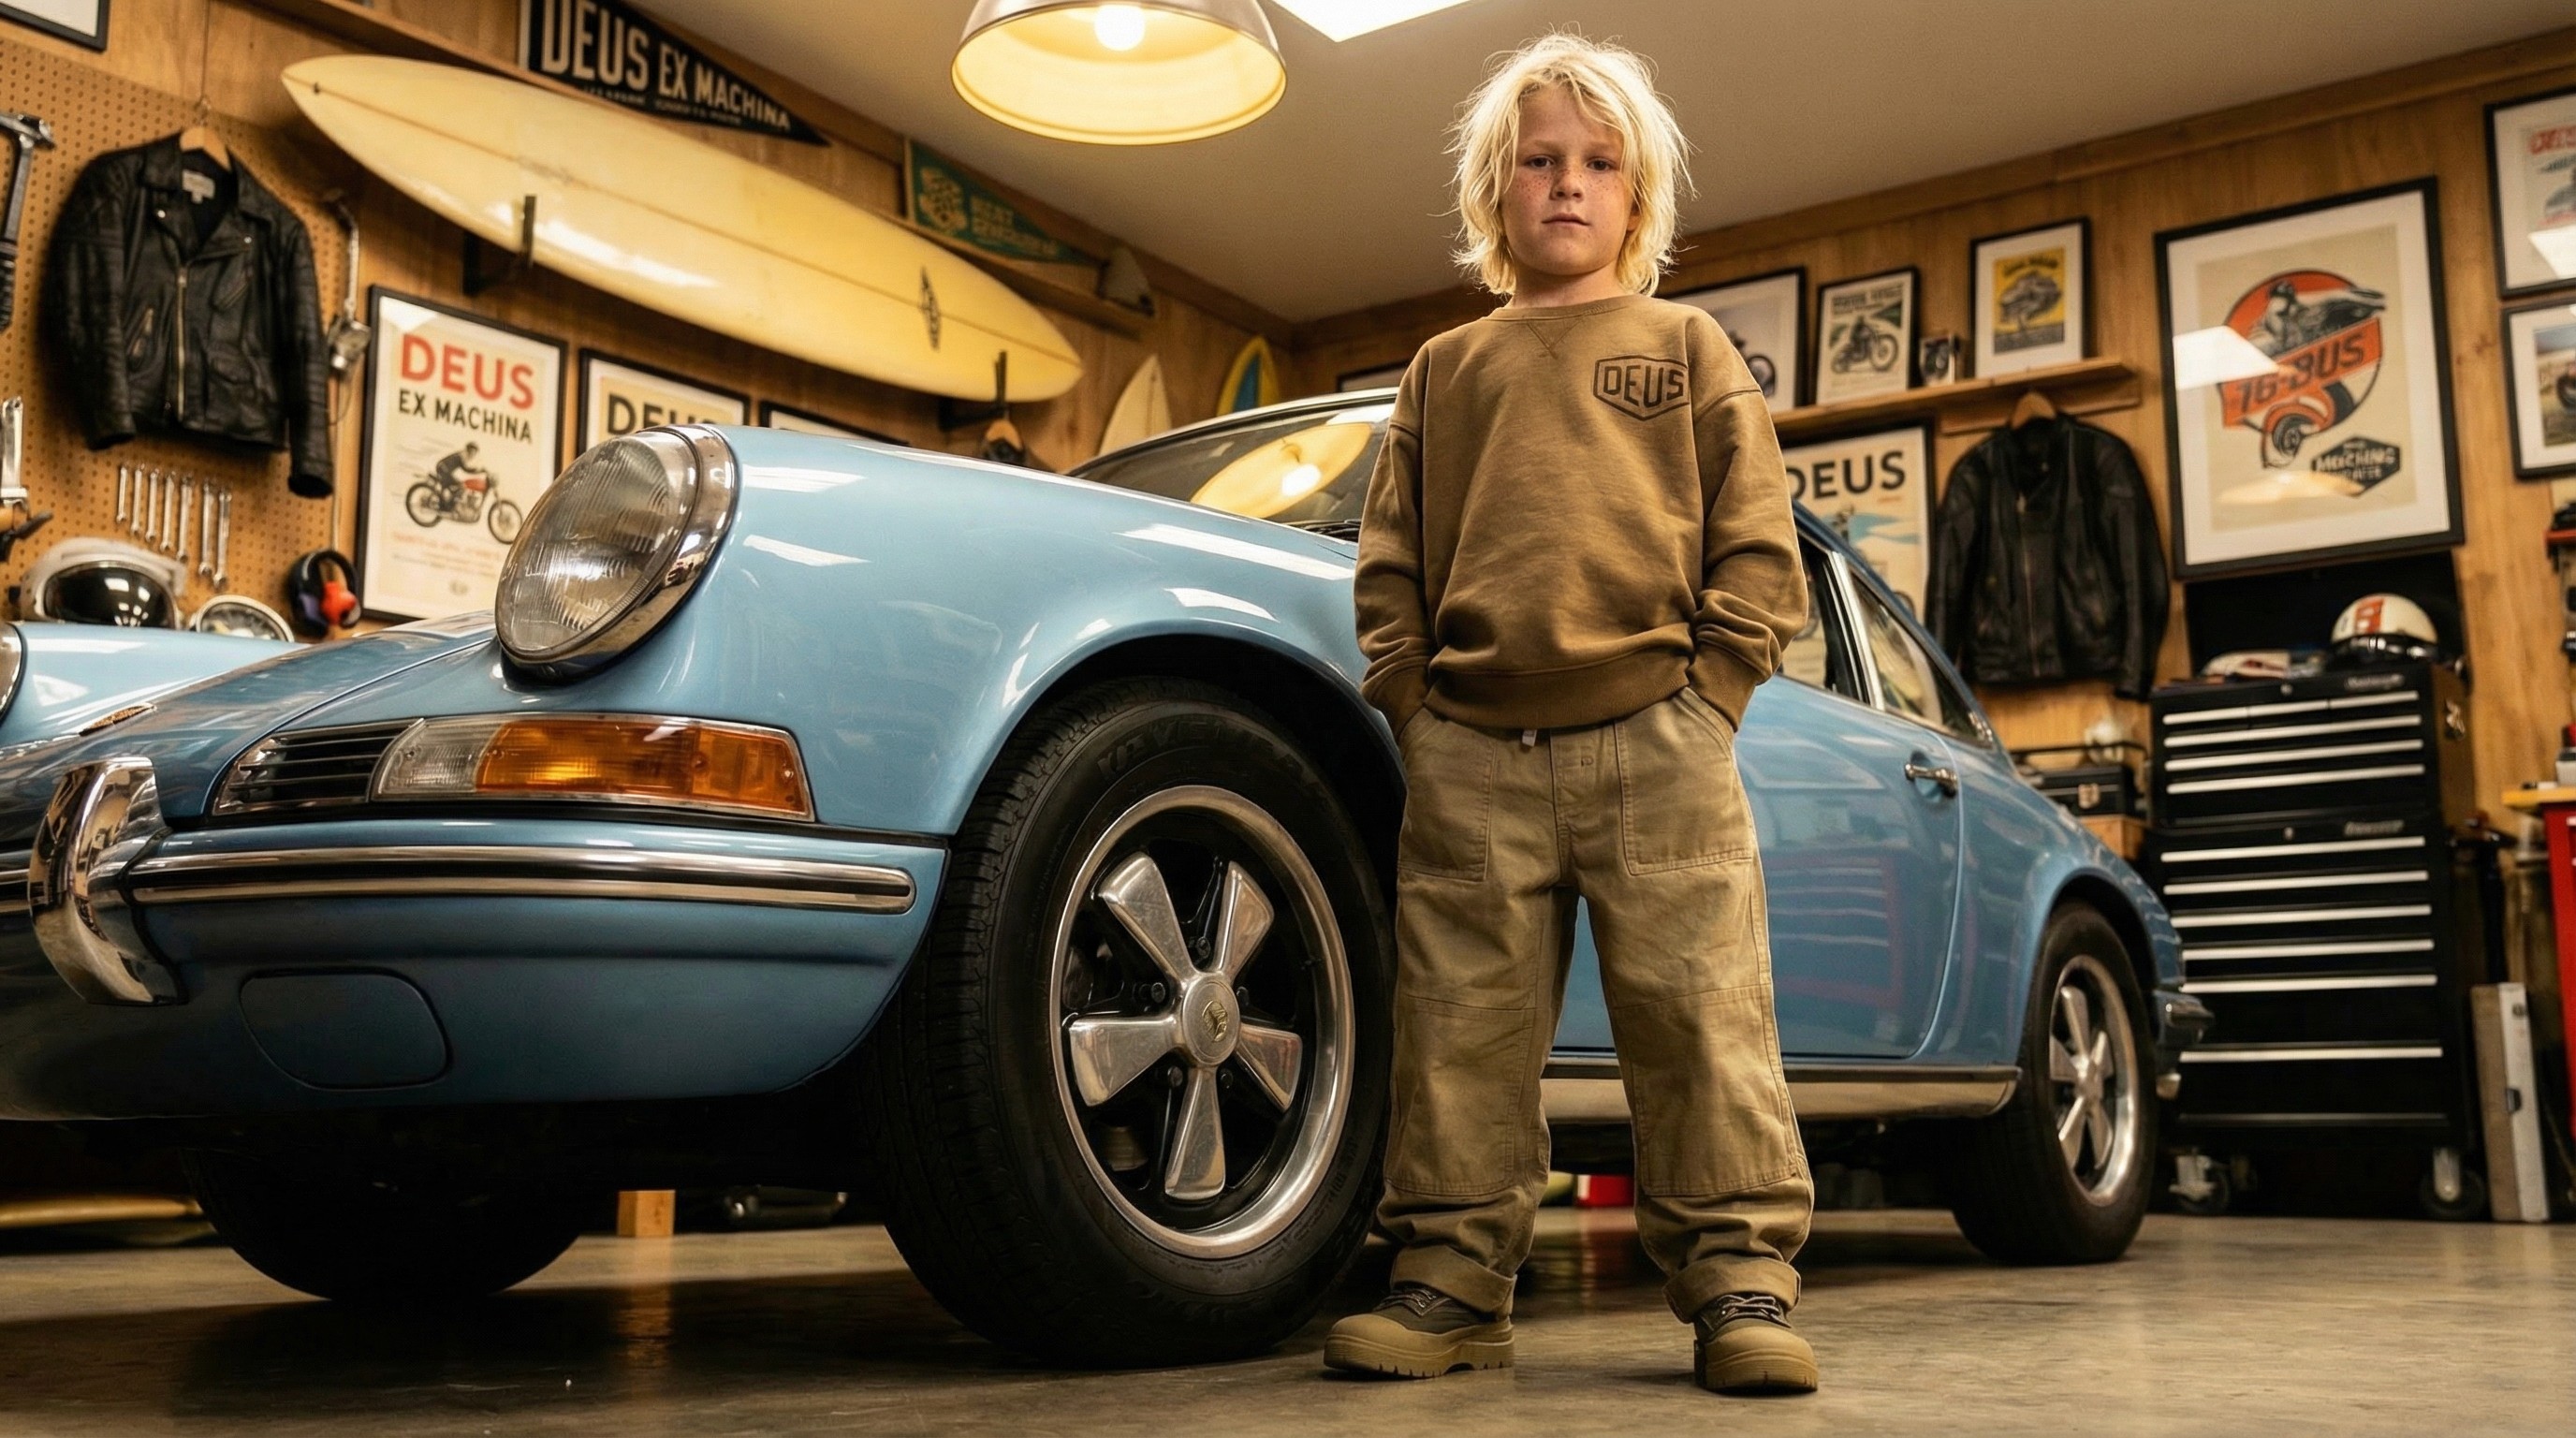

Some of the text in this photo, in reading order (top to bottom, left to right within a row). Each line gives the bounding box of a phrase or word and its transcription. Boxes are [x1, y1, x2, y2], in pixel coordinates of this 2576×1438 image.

[541, 0, 791, 130] DEUS EX MACHINA
[401, 333, 534, 410] DEUS
[1603, 364, 1684, 408] DEUS
[398, 388, 533, 444] EX MACHINA
[607, 393, 716, 435] DE
